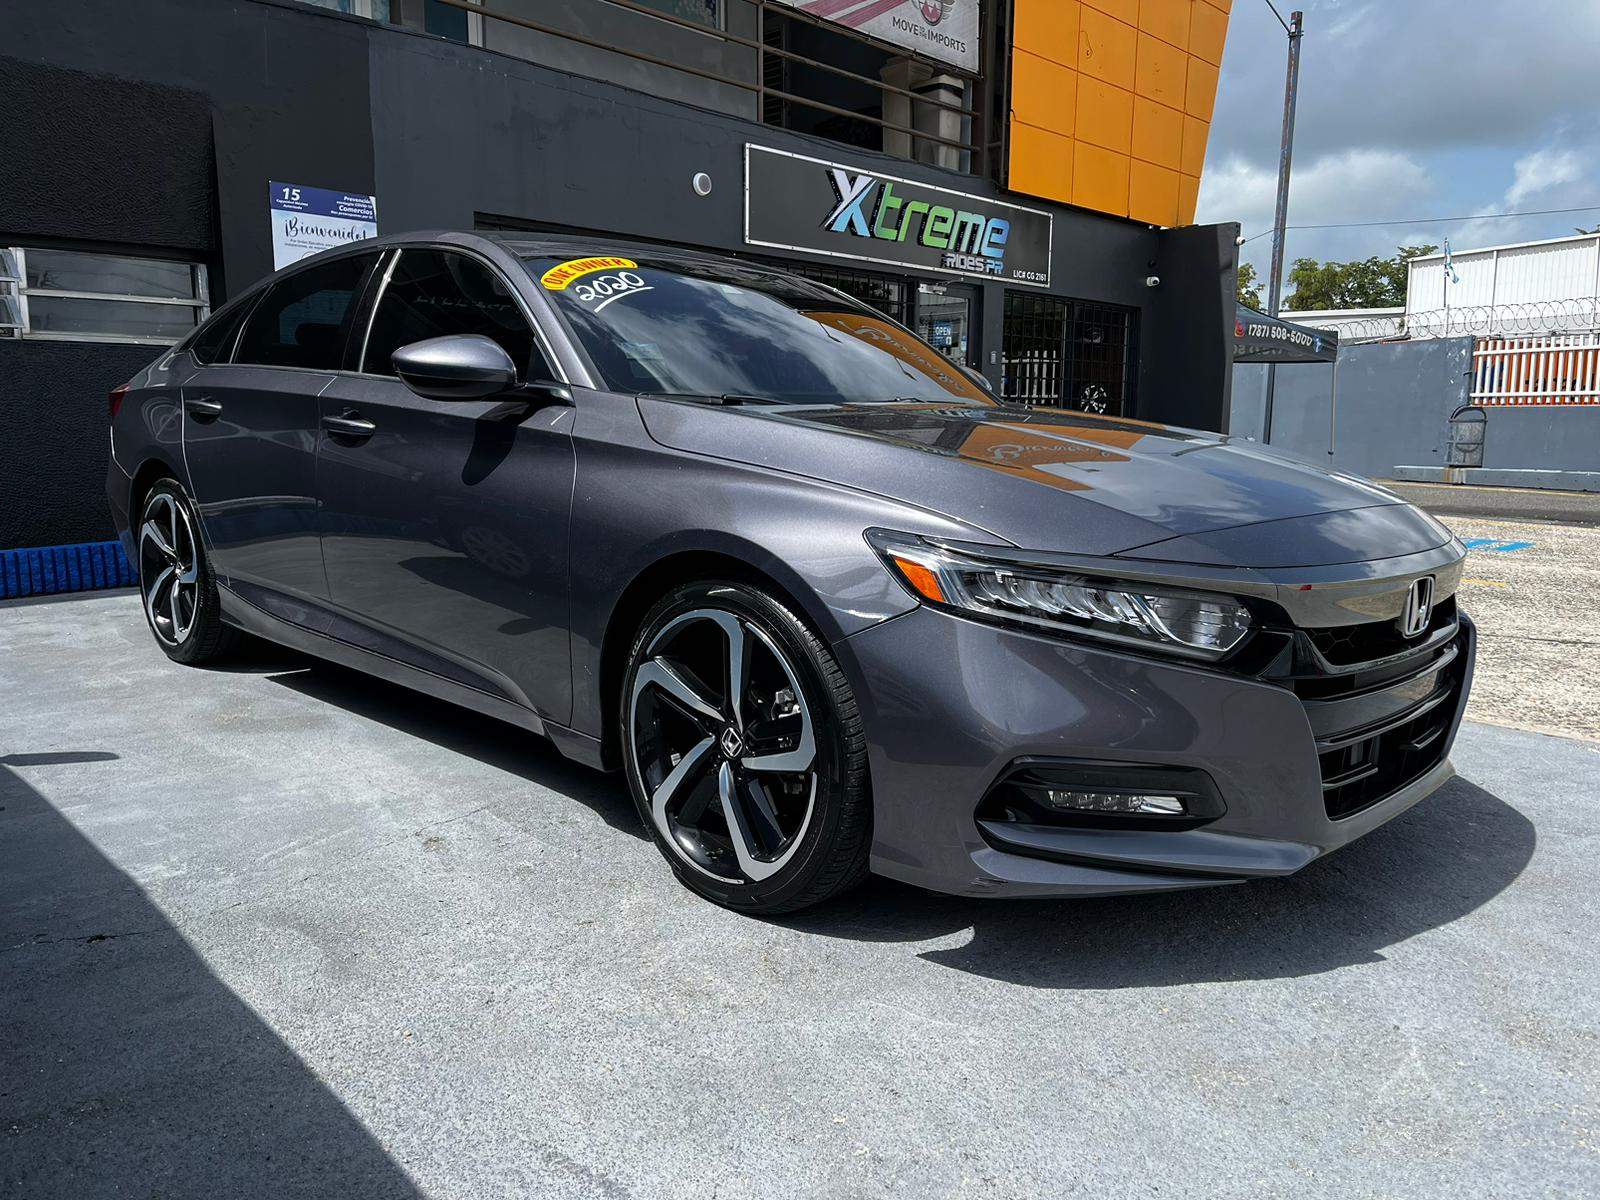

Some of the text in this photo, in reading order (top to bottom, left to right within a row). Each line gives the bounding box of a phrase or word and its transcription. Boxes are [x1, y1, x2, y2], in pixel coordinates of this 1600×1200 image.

[892, 16, 919, 36] MOVE
[927, 29, 966, 53] IMPORTS
[282, 187, 301, 201] 15
[338, 204, 373, 216] Comercios
[822, 168, 1010, 258] Xtreme
[544, 258, 627, 285] ONE OWNER
[943, 252, 1004, 275] RIDES PR
[575, 271, 645, 300] 2020
[1026, 271, 1035, 280] CG
[1271, 326, 1313, 347] 508-5000
